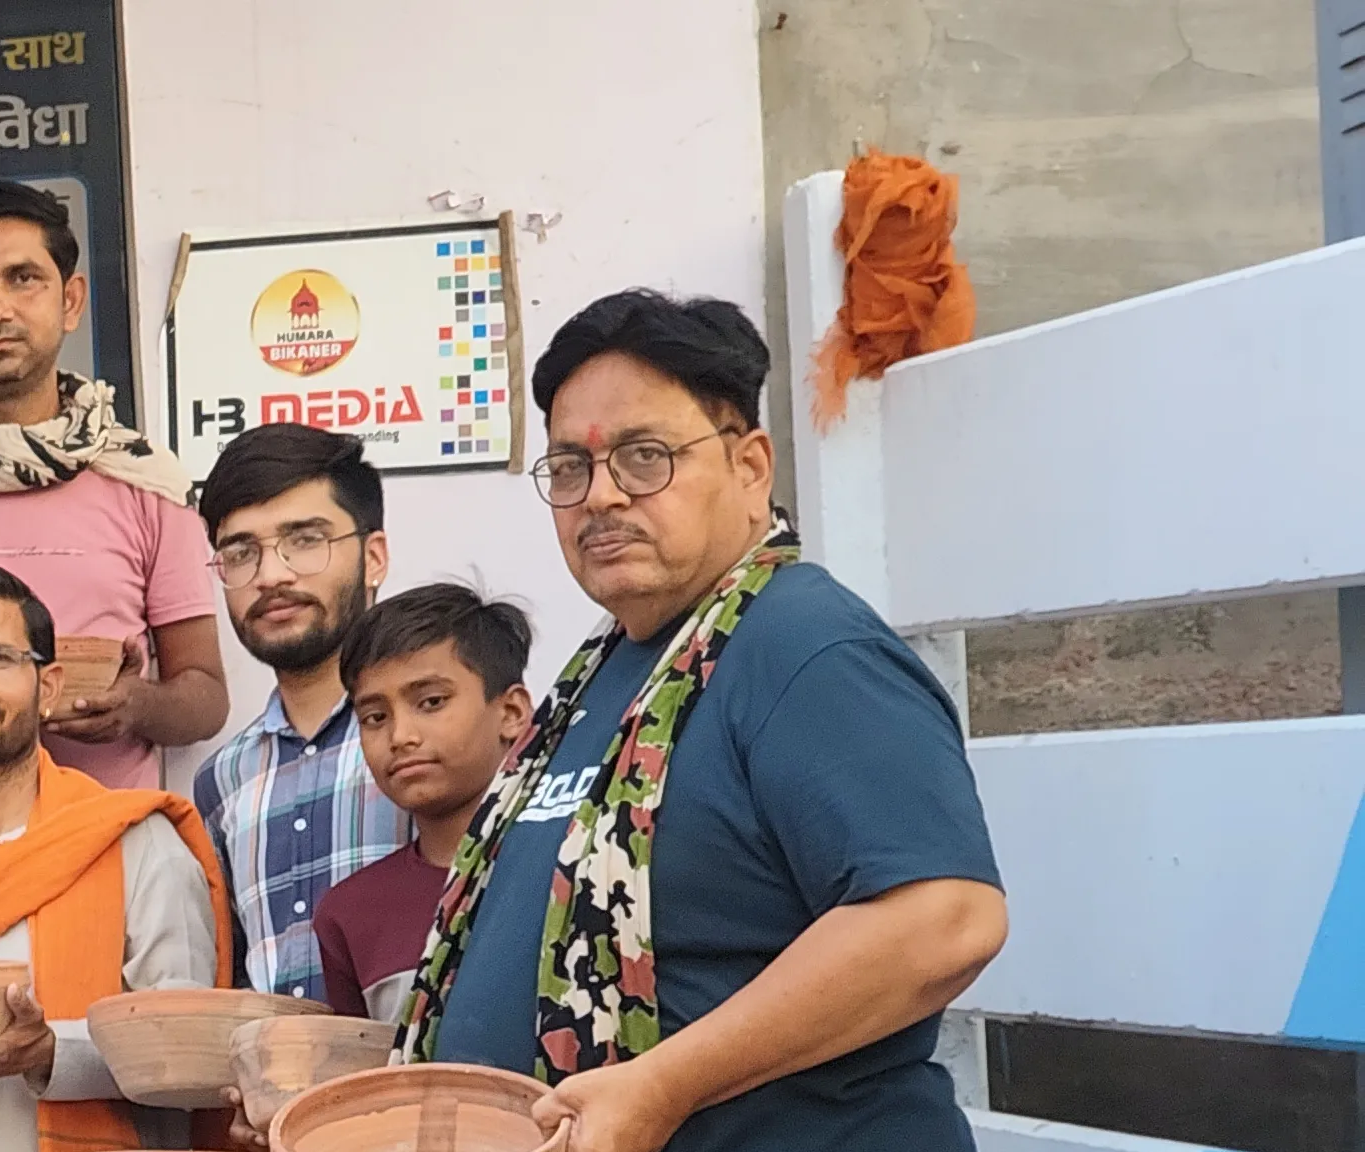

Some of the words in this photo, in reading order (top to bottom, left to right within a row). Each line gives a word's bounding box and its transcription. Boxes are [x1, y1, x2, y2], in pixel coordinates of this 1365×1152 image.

[3, 31, 85, 70] साथ
[276, 328, 335, 343] HUMARA
[270, 342, 342, 361] BIKANER
